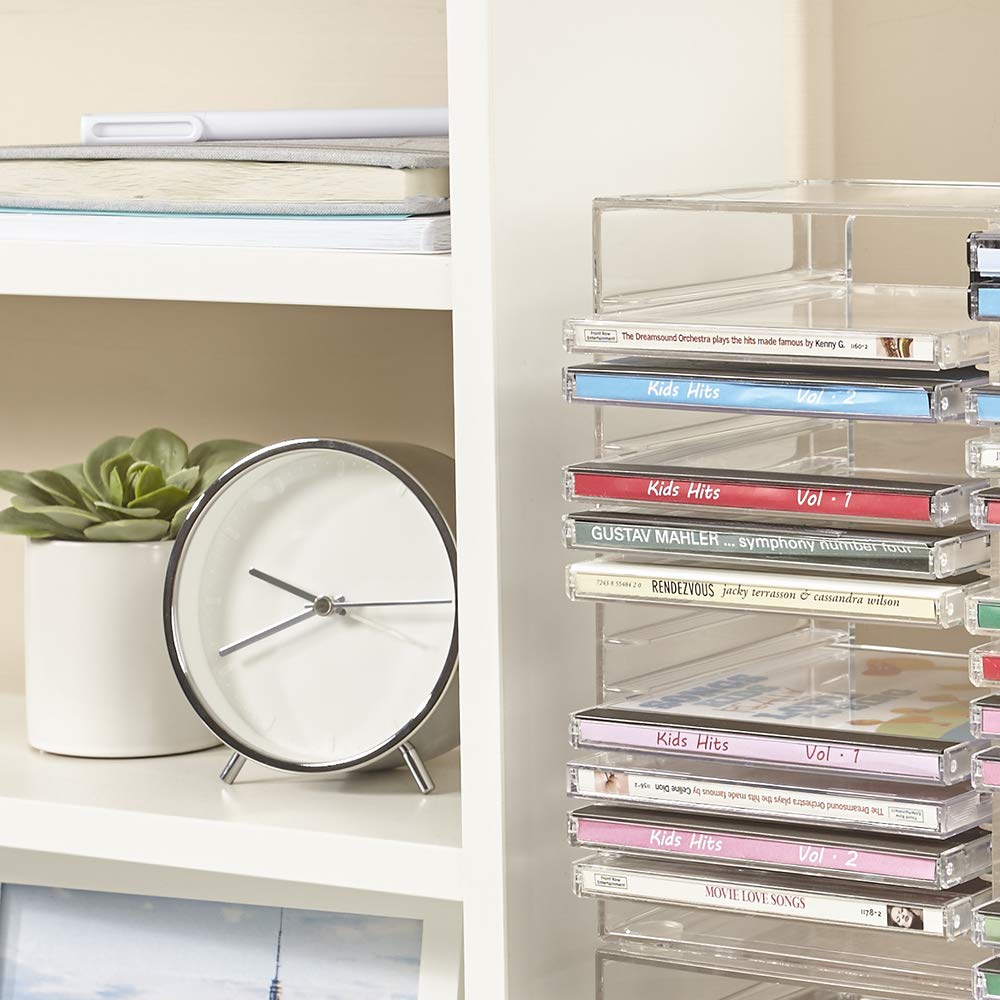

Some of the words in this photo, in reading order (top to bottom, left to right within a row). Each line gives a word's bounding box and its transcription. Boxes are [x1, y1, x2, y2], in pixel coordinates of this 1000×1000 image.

[622, 332, 634, 341] The
[635, 333, 677, 343] Dreamsound
[679, 334, 711, 344] Orchestra
[712, 335, 730, 346] plays
[731, 335, 742, 344] the
[743, 335, 756, 345] hits
[757, 336, 778, 346] made
[778, 337, 803, 347] famous
[805, 338, 814, 349] by
[815, 339, 837, 350] Kenny
[838, 340, 846, 349] G.
[647, 479, 679, 497] Kids
[687, 481, 720, 500] Hits
[796, 489, 823, 507] Vol
[843, 492, 852, 508] 1
[590, 525, 651, 543] GUSTAV
[654, 528, 719, 547] MAHLER
[738, 535, 816, 553] symphony
[652, 578, 714, 598] RENDEZVOUS
[721, 583, 748, 600] jacky
[752, 586, 796, 601] terrasson
[800, 587, 810, 602] &
[813, 588, 863, 605] cassandra
[866, 593, 900, 607] wilson
[656, 731, 688, 748] Kids
[697, 733, 729, 751] Hits
[806, 745, 830, 761] Vol
[854, 749, 861, 764] 1
[704, 884, 739, 902] MOVIE
[741, 888, 769, 906] LOVE
[771, 892, 806, 910] SONGS
